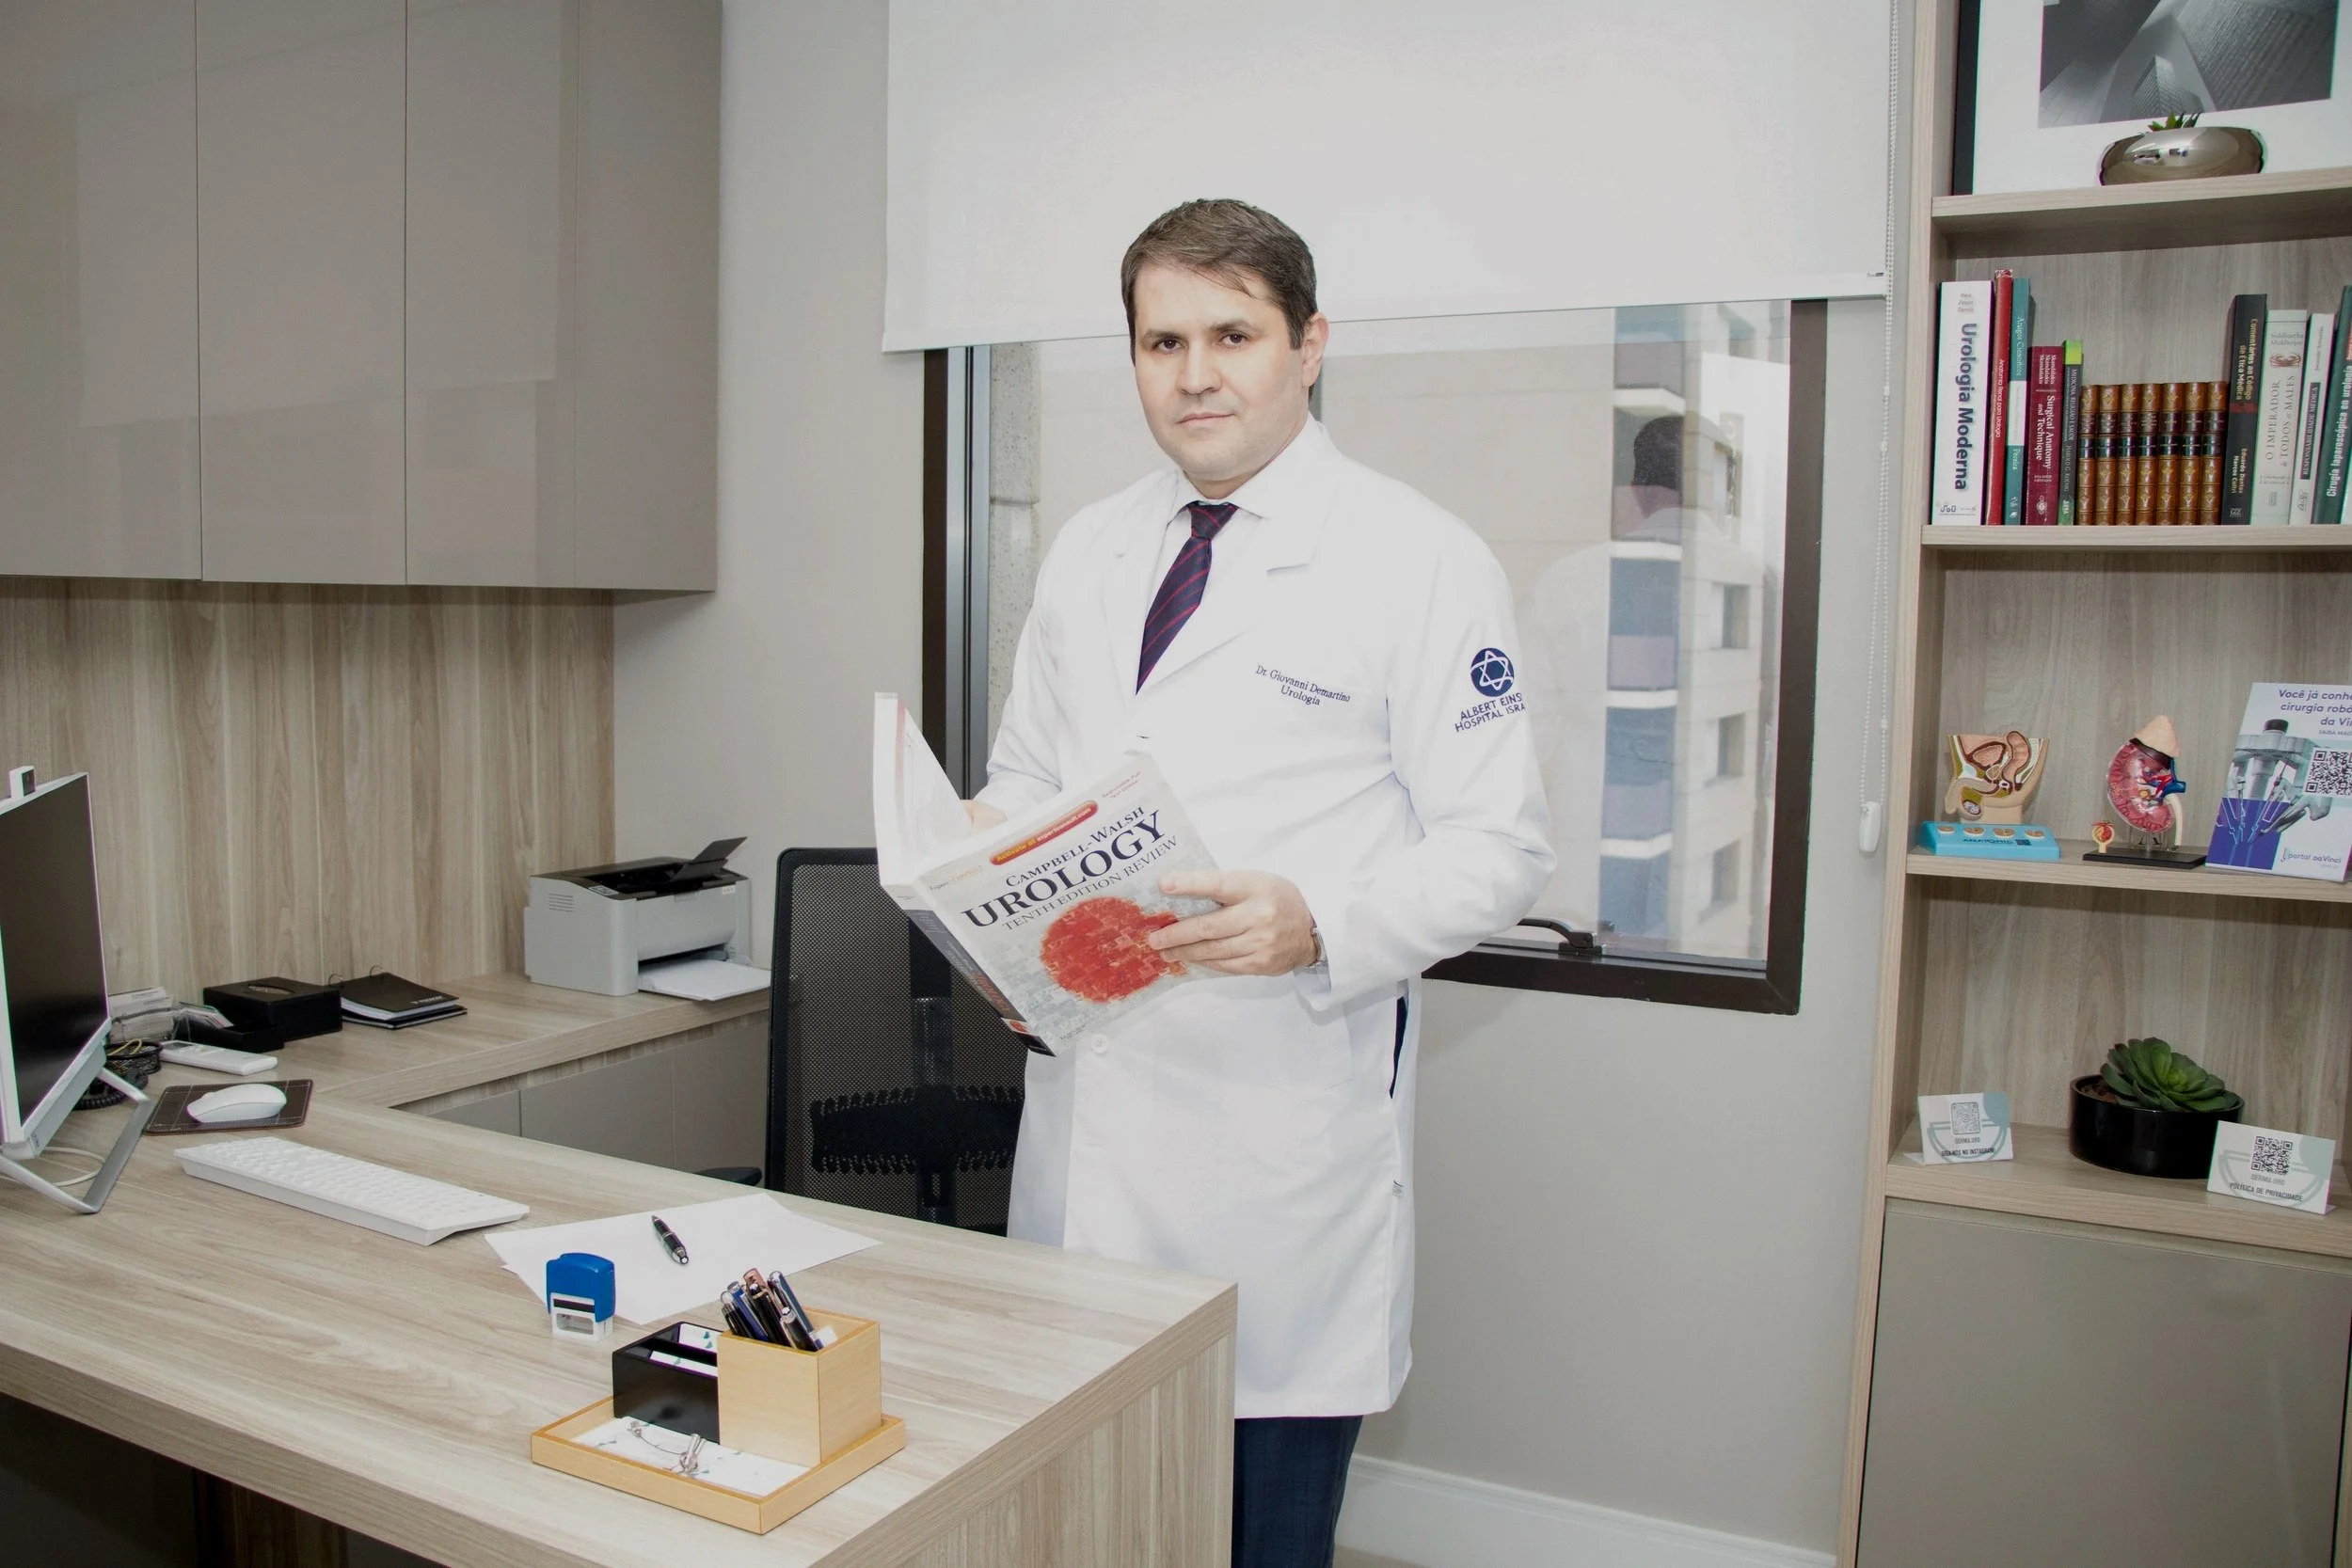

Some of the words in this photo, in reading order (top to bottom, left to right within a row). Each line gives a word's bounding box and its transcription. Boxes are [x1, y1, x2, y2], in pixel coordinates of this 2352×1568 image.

[2239, 344, 2247, 355] de
[2248, 318, 2258, 364] Comentários
[1955, 323, 1978, 403] Urologia
[2247, 365, 2253, 374] ao
[2244, 375, 2254, 400] Código
[2284, 375, 2295, 410] MALES
[2044, 395, 2056, 429] Surgical
[2266, 378, 2280, 448] IMPERADOR
[2341, 399, 2349, 410] en
[1994, 416, 2003, 438] Urologia
[2034, 419, 2045, 461] Technique
[2280, 420, 2290, 457] TODOS
[2330, 412, 2348, 467] laparoscópica
[1954, 407, 1974, 490] Moderna
[2012, 449, 2021, 470] Pereira
[2042, 433, 2055, 469] Anatomy
[2265, 451, 2274, 460] O
[2302, 413, 2316, 475] RESPONSABILIDADE
[2326, 468, 2341, 497] Cirugía
[1255, 664, 1267, 676] Dr.
[1269, 669, 1310, 690] Giovanni
[1310, 683, 1350, 703] Demartino
[1280, 685, 1321, 705] Urologia
[2279, 689, 2305, 699] Você
[2306, 689, 2318, 702] já
[1454, 707, 1503, 733] HOSPITAL
[1460, 700, 1497, 721] ALBERT
[2280, 702, 2324, 714] cirurgia
[2327, 703, 2352, 714] robó
[2320, 717, 2335, 726] da
[997, 843, 1026, 862] Activate
[1026, 838, 1036, 847] at
[1037, 807, 1091, 842] expertconsult.com
[961, 809, 1165, 928] UROLOGY
[1002, 897, 1054, 931] TENTH
[1056, 871, 1122, 907] EDITION
[1123, 834, 1179, 873] REVIEW
[2265, 1189, 2303, 1202] PRIVACIDADE
